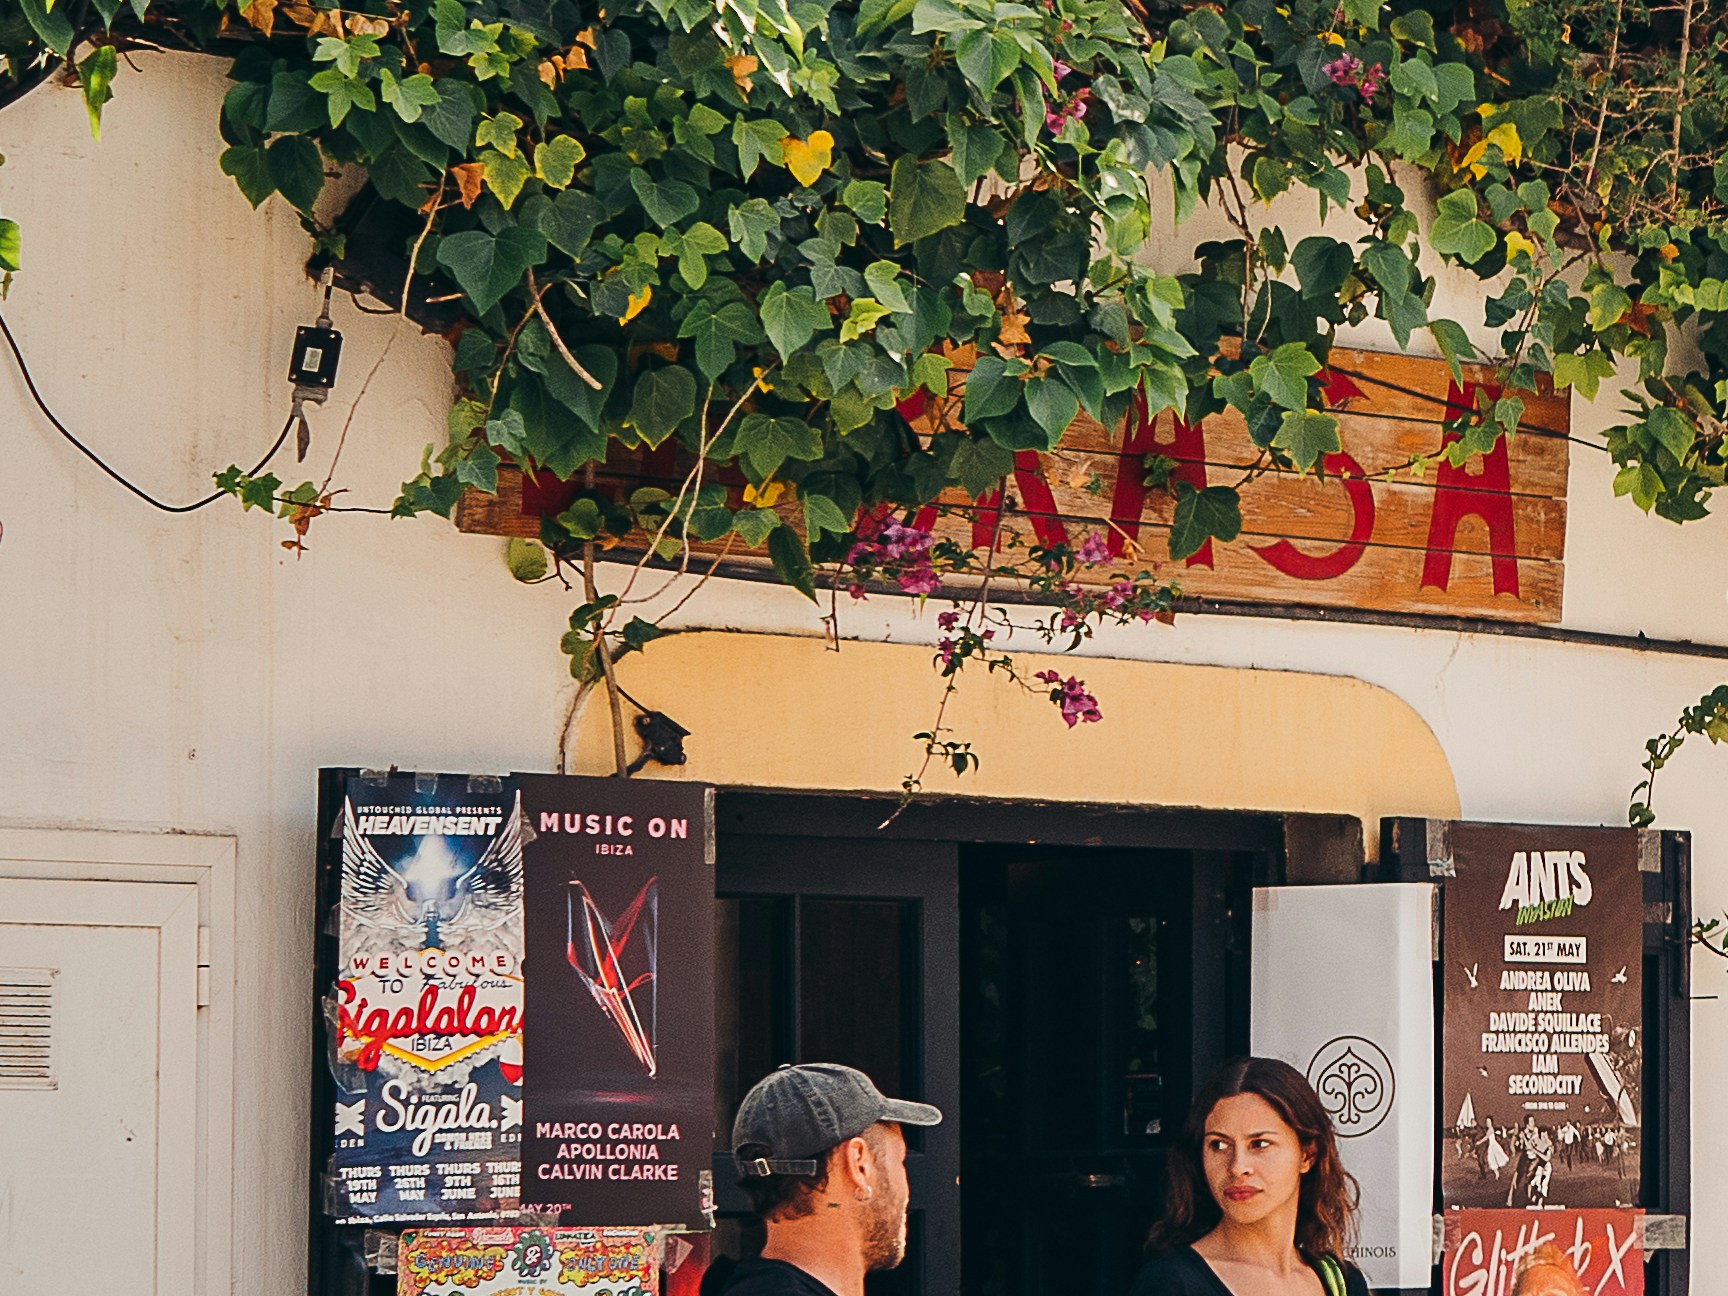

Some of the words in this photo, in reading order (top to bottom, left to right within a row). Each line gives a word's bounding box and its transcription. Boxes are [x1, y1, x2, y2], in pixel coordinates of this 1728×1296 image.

[416, 806, 452, 814] GLOBAL
[456, 806, 502, 815] PRESENTS
[357, 816, 503, 835] HEAVENSENT
[540, 811, 634, 836] MUSIC
[648, 817, 688, 839] ON
[595, 844, 634, 855] IBIZA
[1499, 850, 1592, 910] ANTS
[1516, 894, 1574, 926] INVASION
[1509, 941, 1531, 956] SAT.
[1534, 942, 1553, 957] 21ST
[1557, 943, 1581, 957] MAY
[353, 955, 507, 969] WELCOME
[379, 979, 403, 993] TO
[420, 974, 513, 993] Fabulous
[1500, 970, 1552, 990] ANDREA
[1553, 971, 1591, 992] OLIVA
[1528, 991, 1563, 1012] ANEK
[1489, 1012, 1536, 1032] DAVIDE
[1537, 1012, 1601, 1033] SQUILLACE
[411, 1036, 453, 1052] IBIZA
[1481, 1032, 1549, 1053] FRANCISCO
[1550, 1033, 1610, 1053] ALLENDES
[1531, 1054, 1559, 1074] IAM
[1508, 1074, 1582, 1095] SECONDCITY
[535, 1122, 602, 1139] MARCO
[607, 1124, 681, 1140] CAROLA
[556, 1143, 660, 1160] APOLLONIA
[339, 1165, 382, 1180] THURS
[388, 1164, 431, 1177] THURS
[436, 1162, 481, 1175] THURS
[537, 1163, 603, 1180] CALVIN
[608, 1164, 679, 1180] CLARKE
[346, 1179, 378, 1191] 19TH
[444, 1175, 472, 1187] 9TH
[348, 1191, 378, 1204] MAY
[398, 1190, 425, 1201] MAY
[440, 1188, 476, 1200] JUNE
[489, 1186, 521, 1199] JUNE
